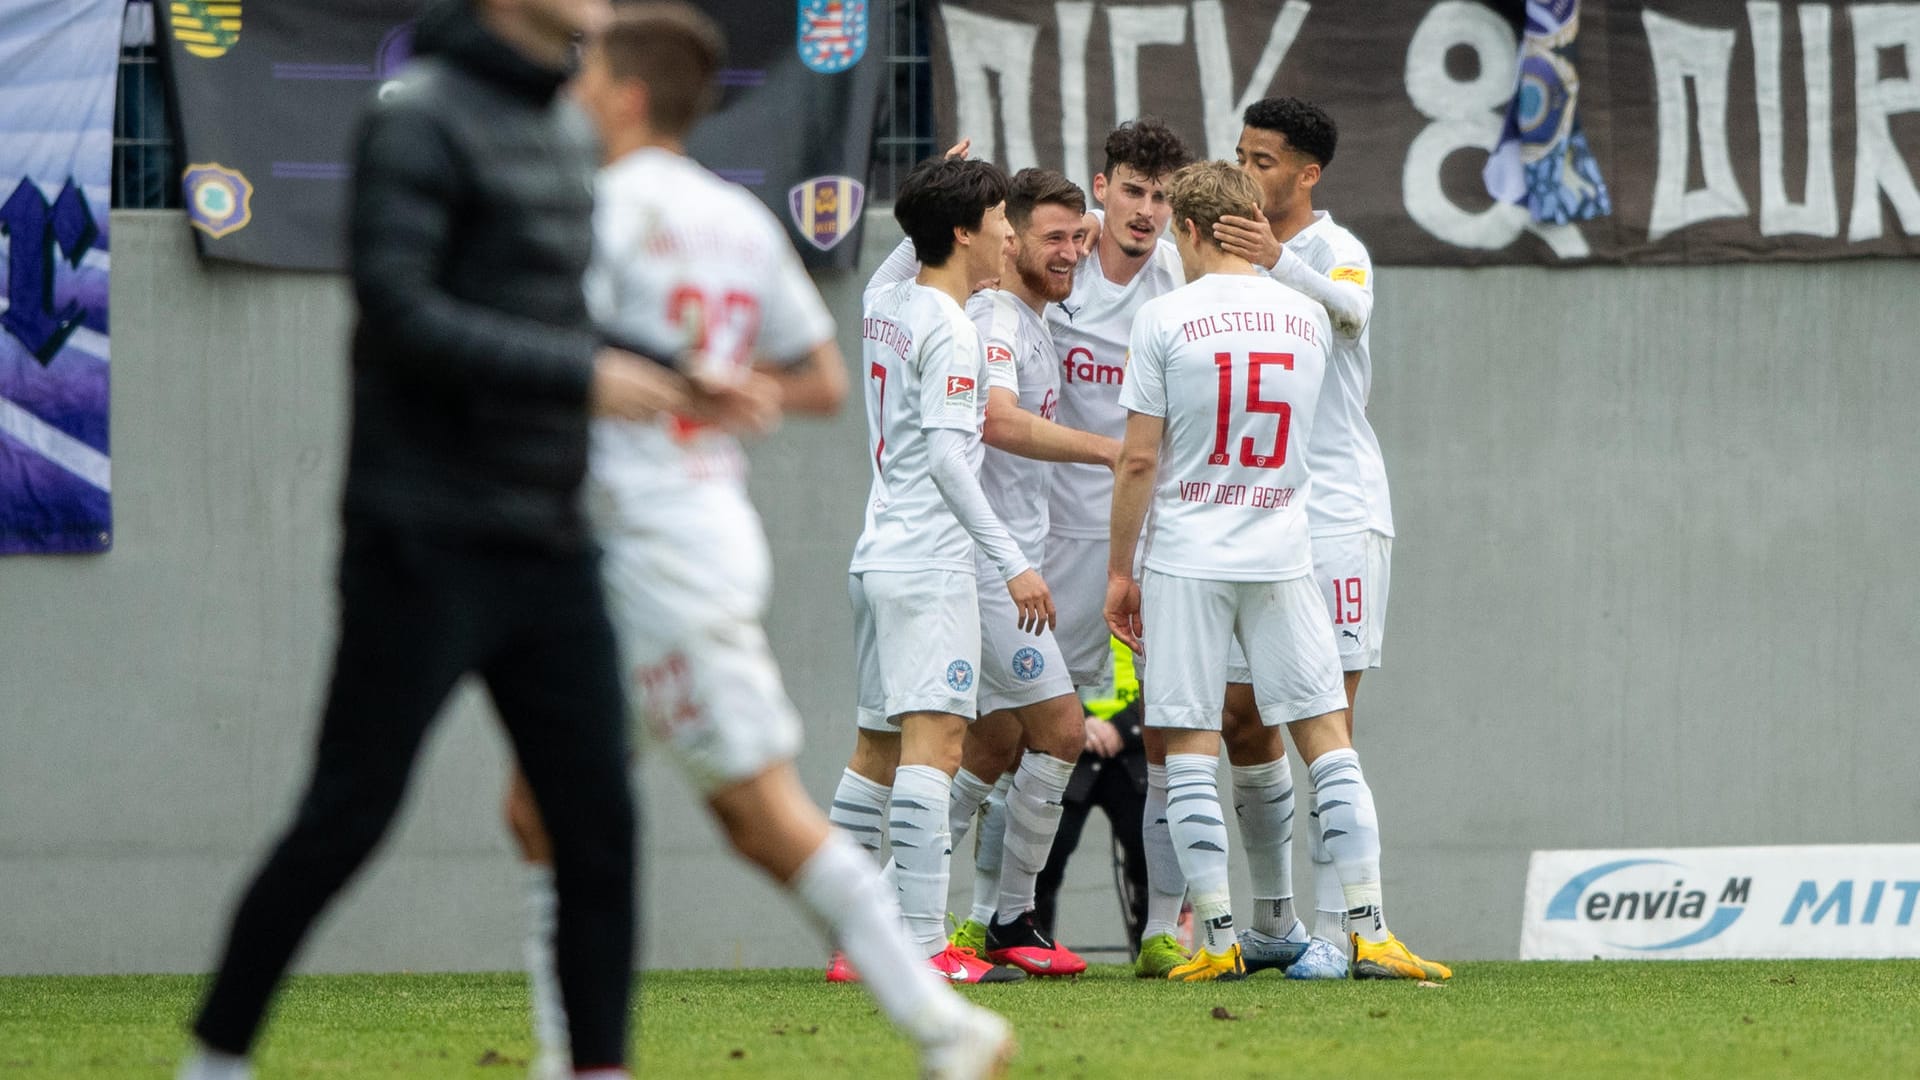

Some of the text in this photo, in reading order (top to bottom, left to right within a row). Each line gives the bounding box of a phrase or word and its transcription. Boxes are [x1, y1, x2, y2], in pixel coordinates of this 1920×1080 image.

[1183, 312, 1317, 347] HOLSTEIN KIEL
[1063, 347, 1124, 385] fam
[1207, 352, 1294, 468] 15
[1179, 480, 1211, 503] VAN
[1214, 484, 1246, 506] DEN
[1333, 577, 1361, 625] 19
[1780, 880, 1920, 925] MIT
